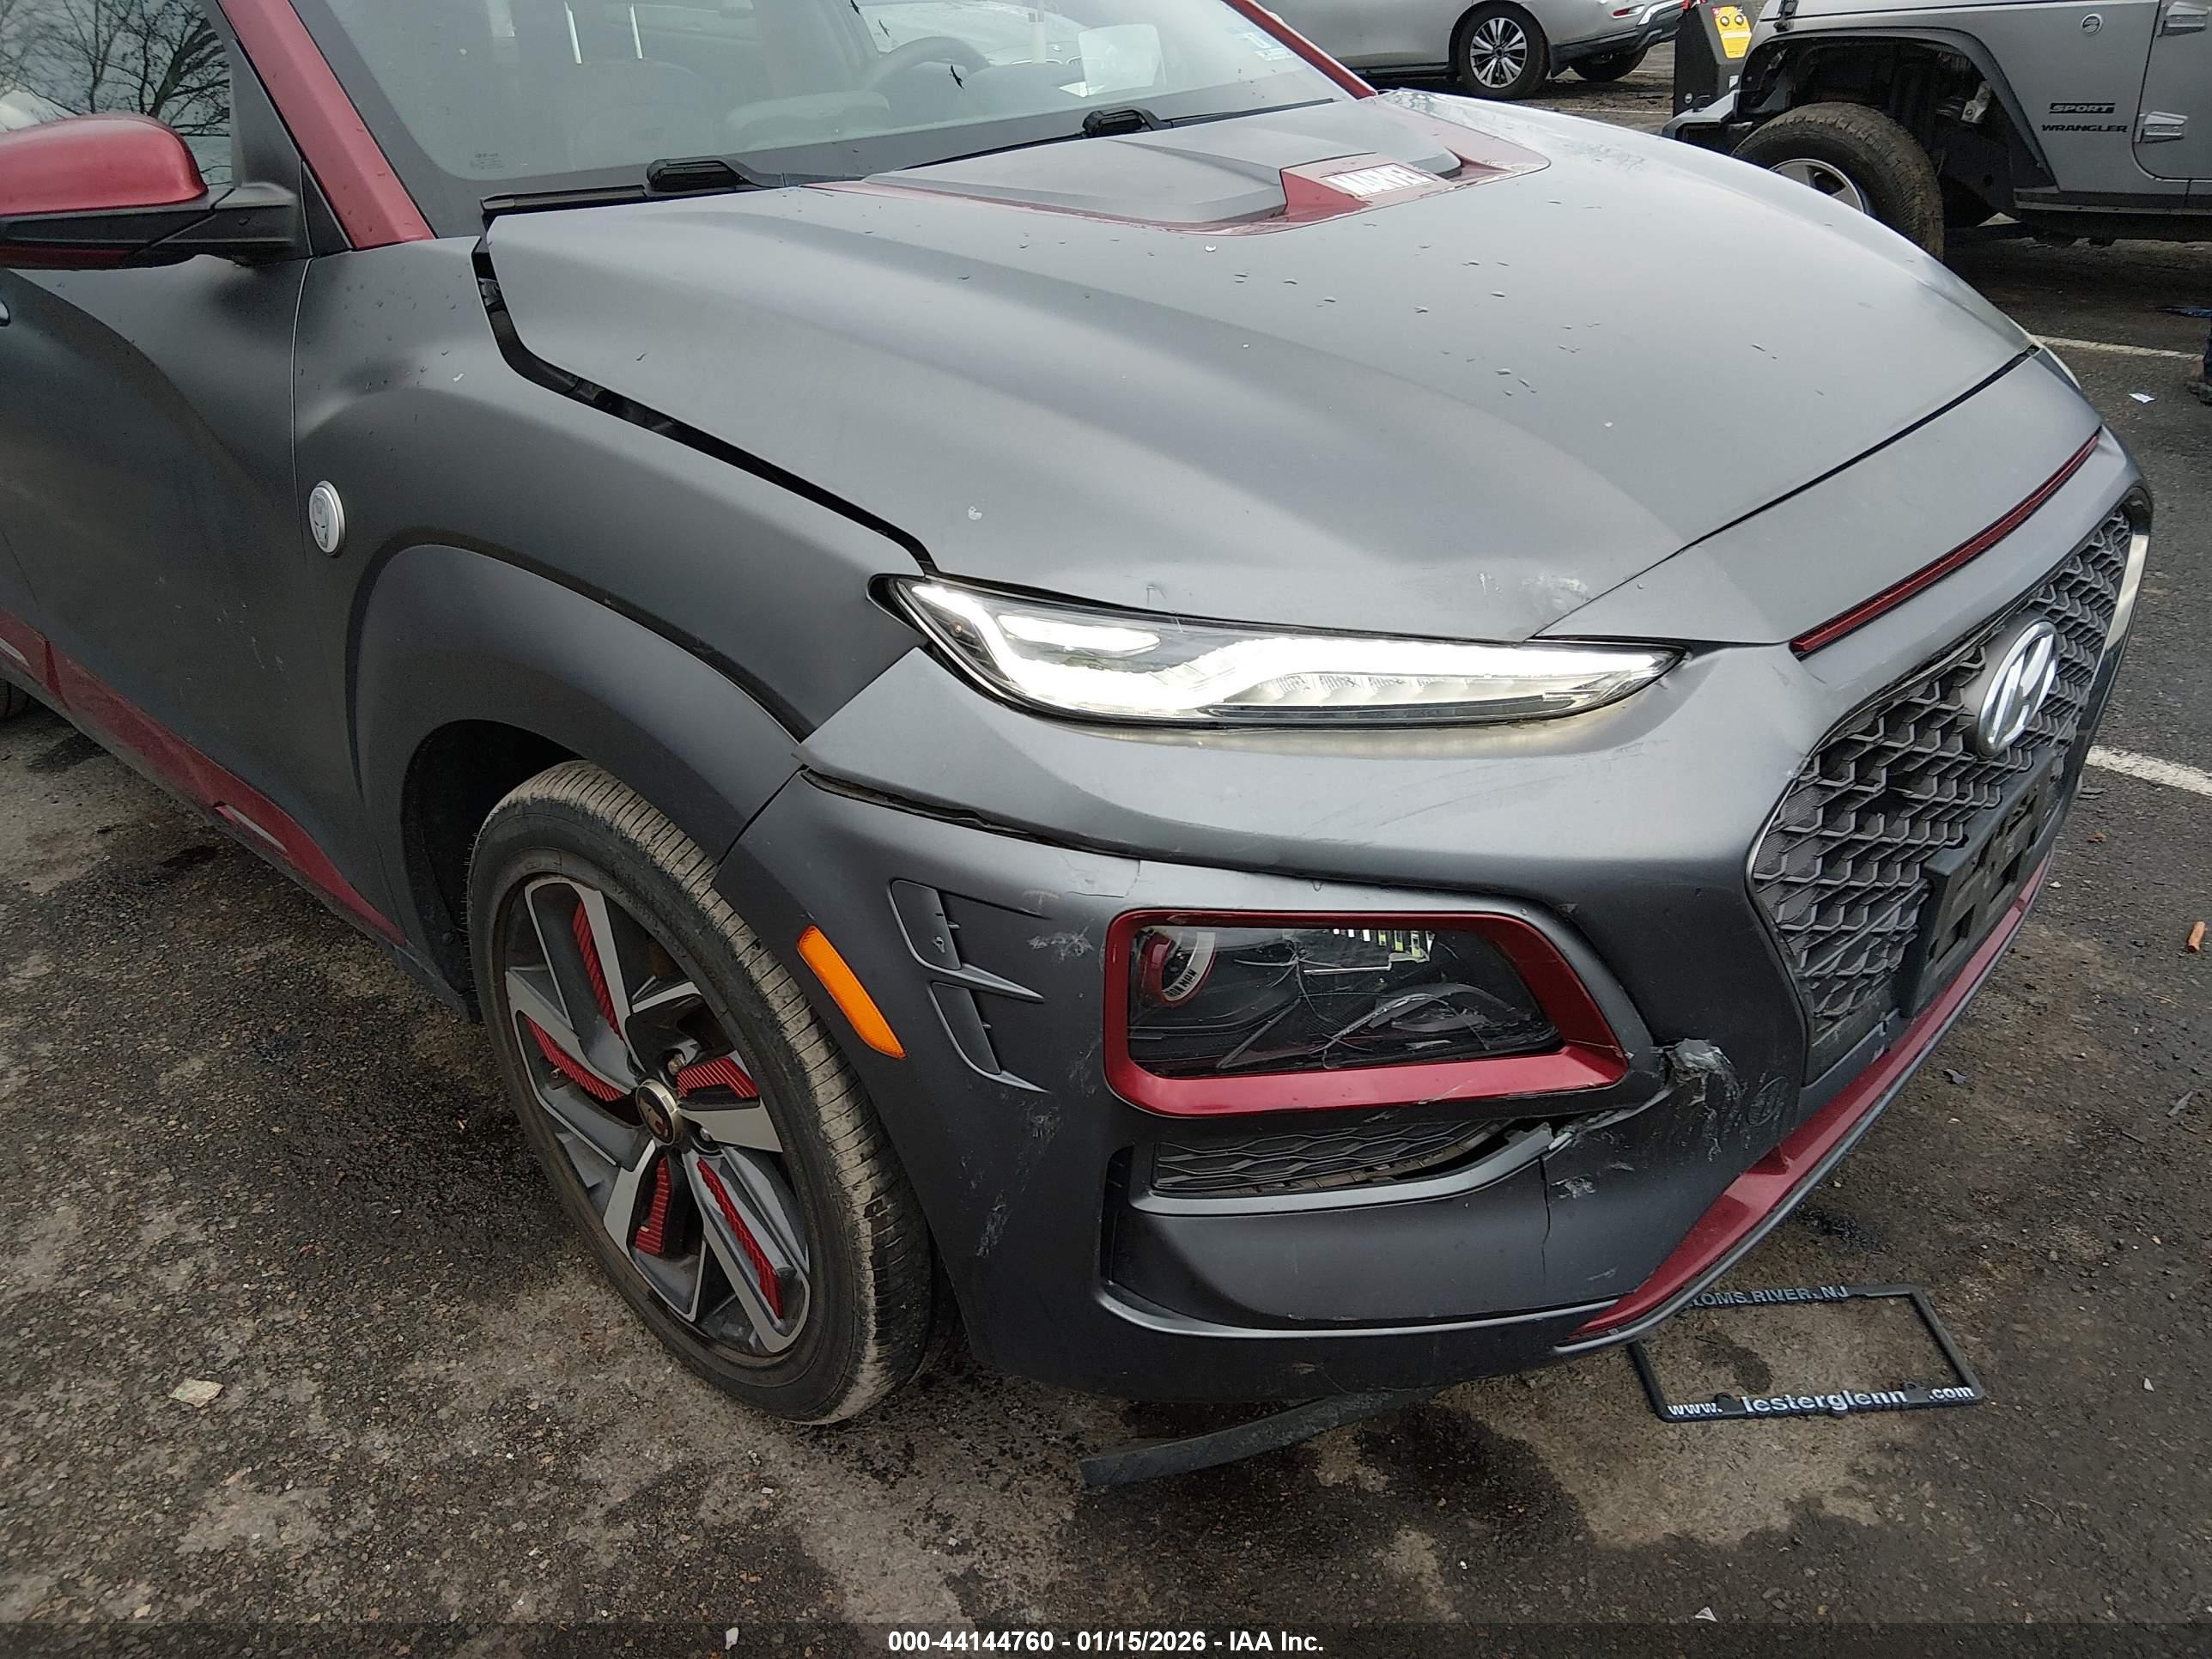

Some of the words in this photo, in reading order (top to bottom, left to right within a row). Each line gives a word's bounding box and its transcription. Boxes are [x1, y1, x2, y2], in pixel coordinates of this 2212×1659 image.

[2048, 104, 2114, 113] SPORT
[1820, 1285, 1849, 1299] NJ
[1667, 1402, 1723, 1416] www.
[1740, 1389, 1909, 1413] lesterglenn
